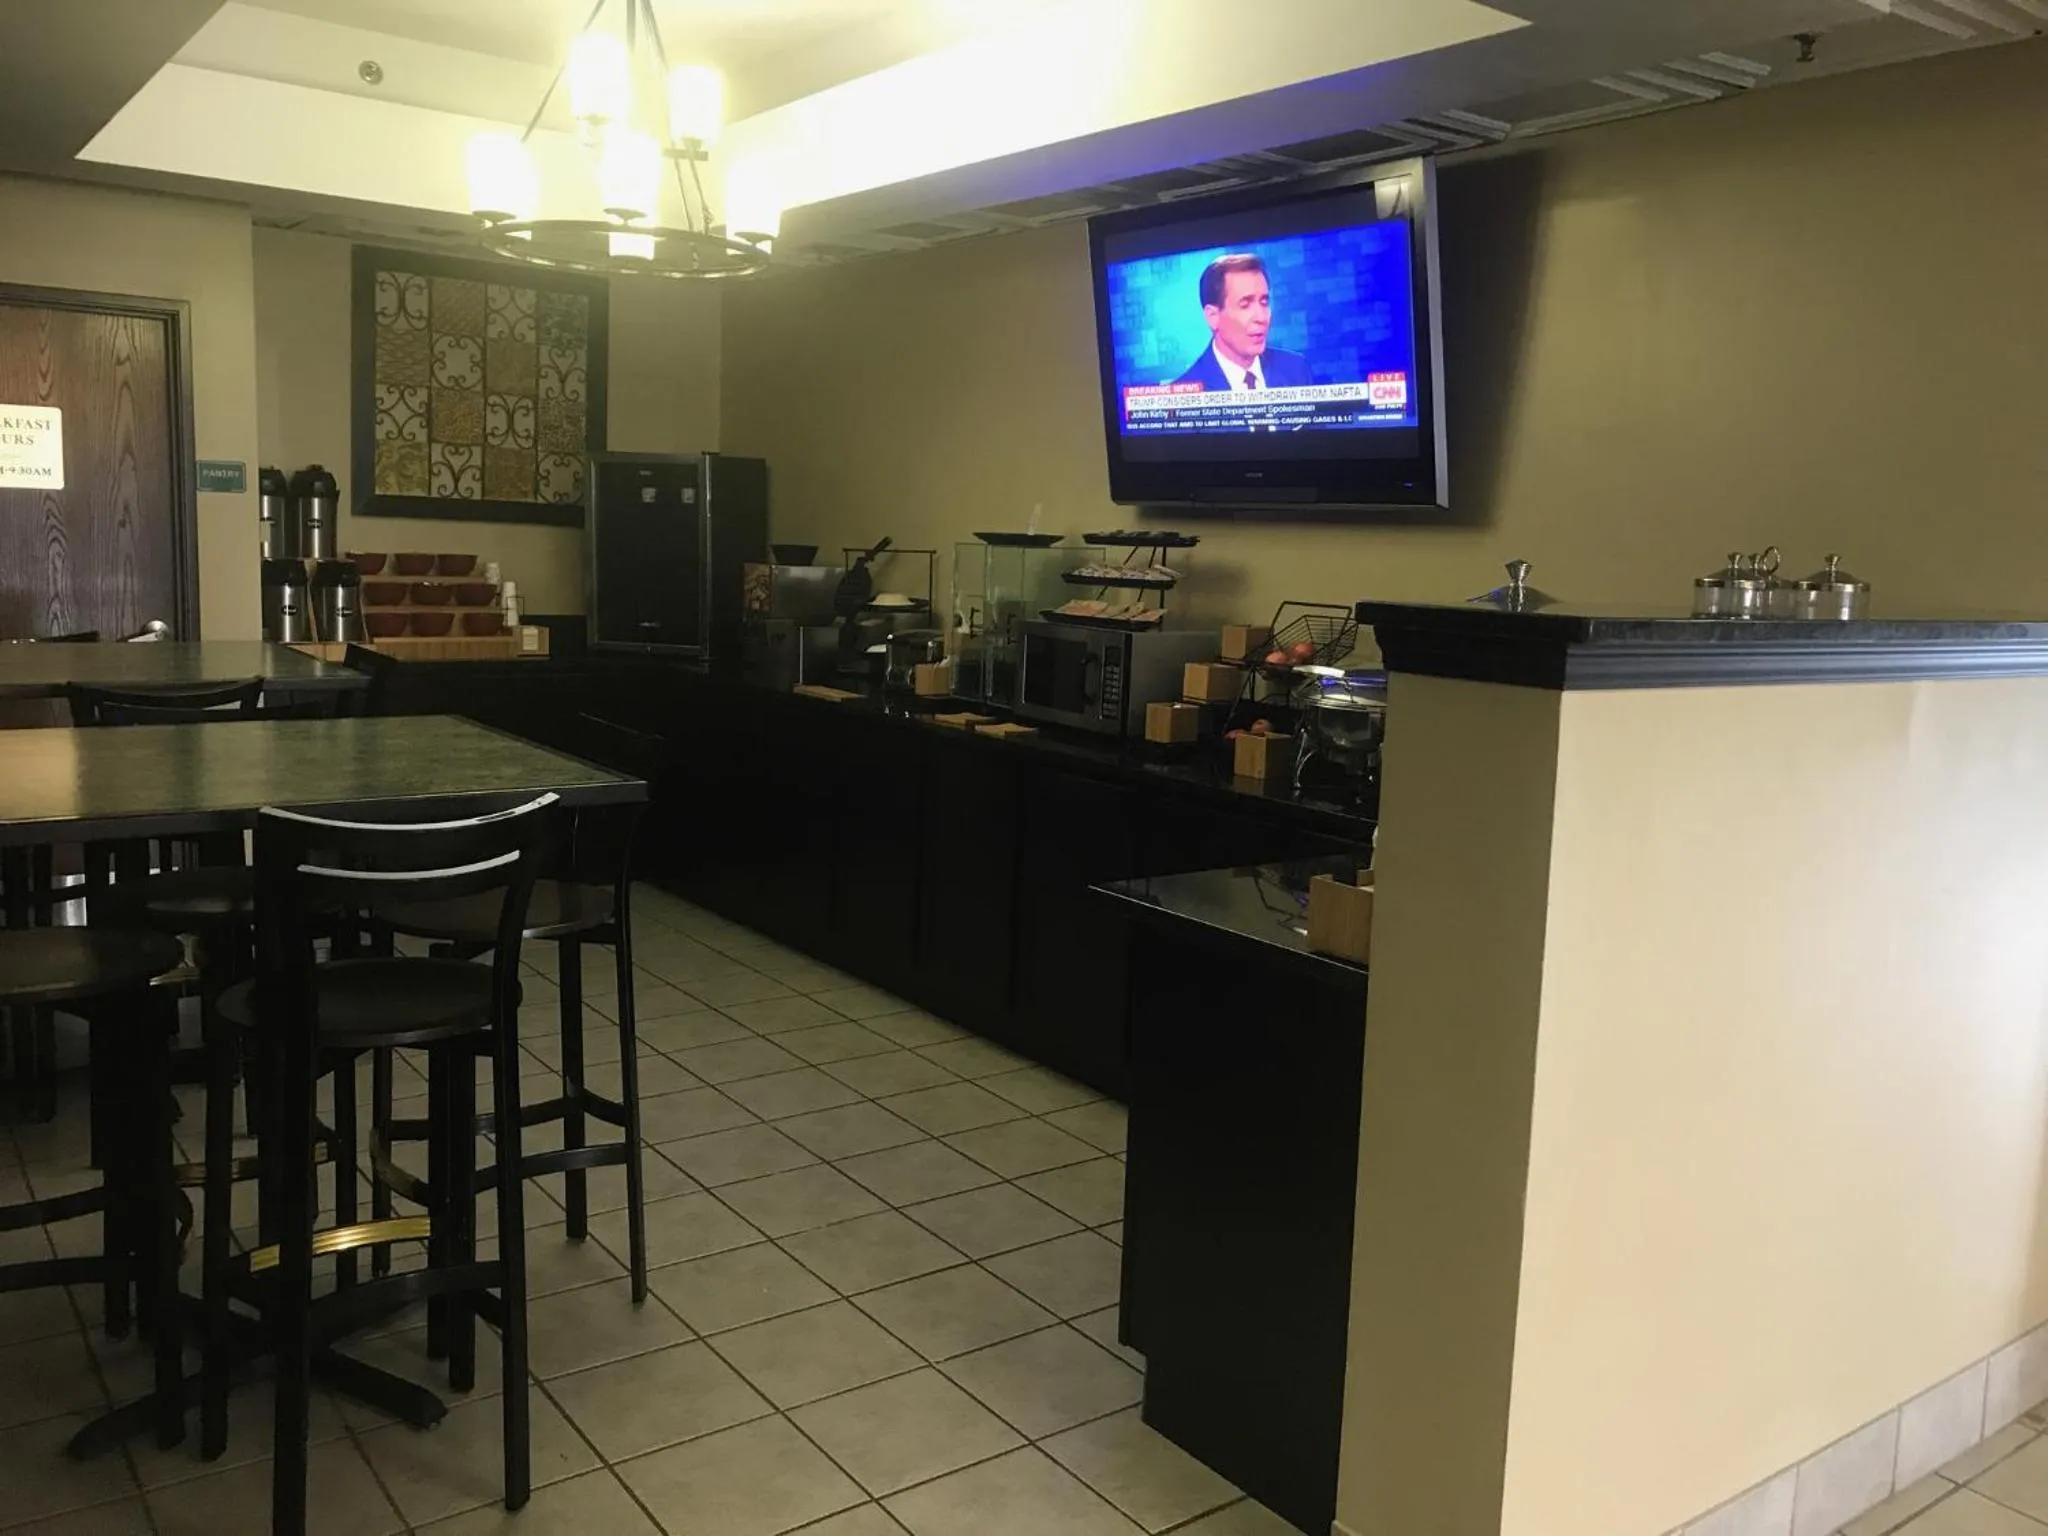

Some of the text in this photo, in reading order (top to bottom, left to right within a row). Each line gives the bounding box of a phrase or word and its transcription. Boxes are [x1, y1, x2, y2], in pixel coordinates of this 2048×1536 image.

[1374, 373, 1401, 381] LIVE
[1128, 383, 1200, 396] BREAKING NEWS
[1373, 386, 1402, 399] CNN
[1130, 386, 1361, 408] TRUMP CONSIDERS ORDER TO WITHDRAW FROM NAFTA
[1131, 403, 1316, 420] John Kirby Former State Department Spokesman
[0, 417, 50, 431] KFAST
[202, 469, 240, 478] PANTRY
